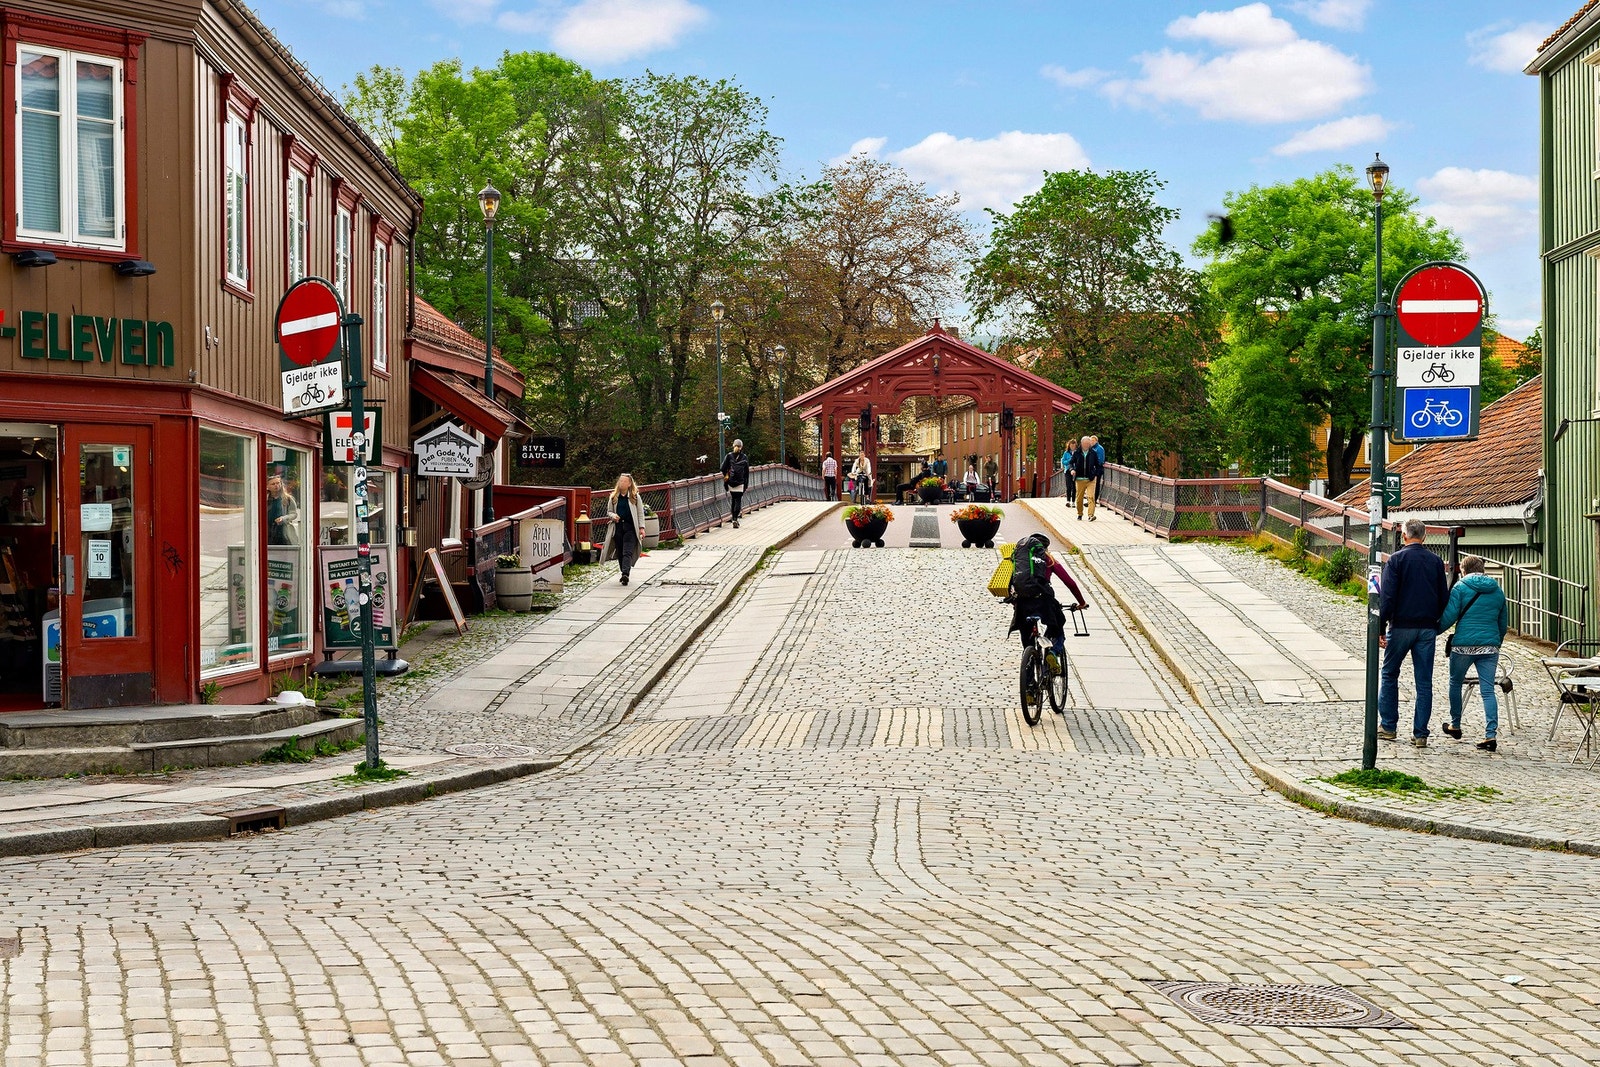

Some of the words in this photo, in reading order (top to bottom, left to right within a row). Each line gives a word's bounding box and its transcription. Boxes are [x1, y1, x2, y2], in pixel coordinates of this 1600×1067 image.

[1402, 349, 1446, 362] Gjelder
[1450, 349, 1475, 359] ikke
[285, 370, 317, 386] Gjelder
[320, 366, 338, 378] ikke
[420, 453, 436, 466] Den
[436, 449, 456, 457] Gode
[456, 452, 474, 468] Nabo
[532, 523, 551, 540] ÅPEN
[95, 553, 105, 561] 10
[532, 542, 551, 557] PUB!
[330, 561, 350, 569] INSTANT
